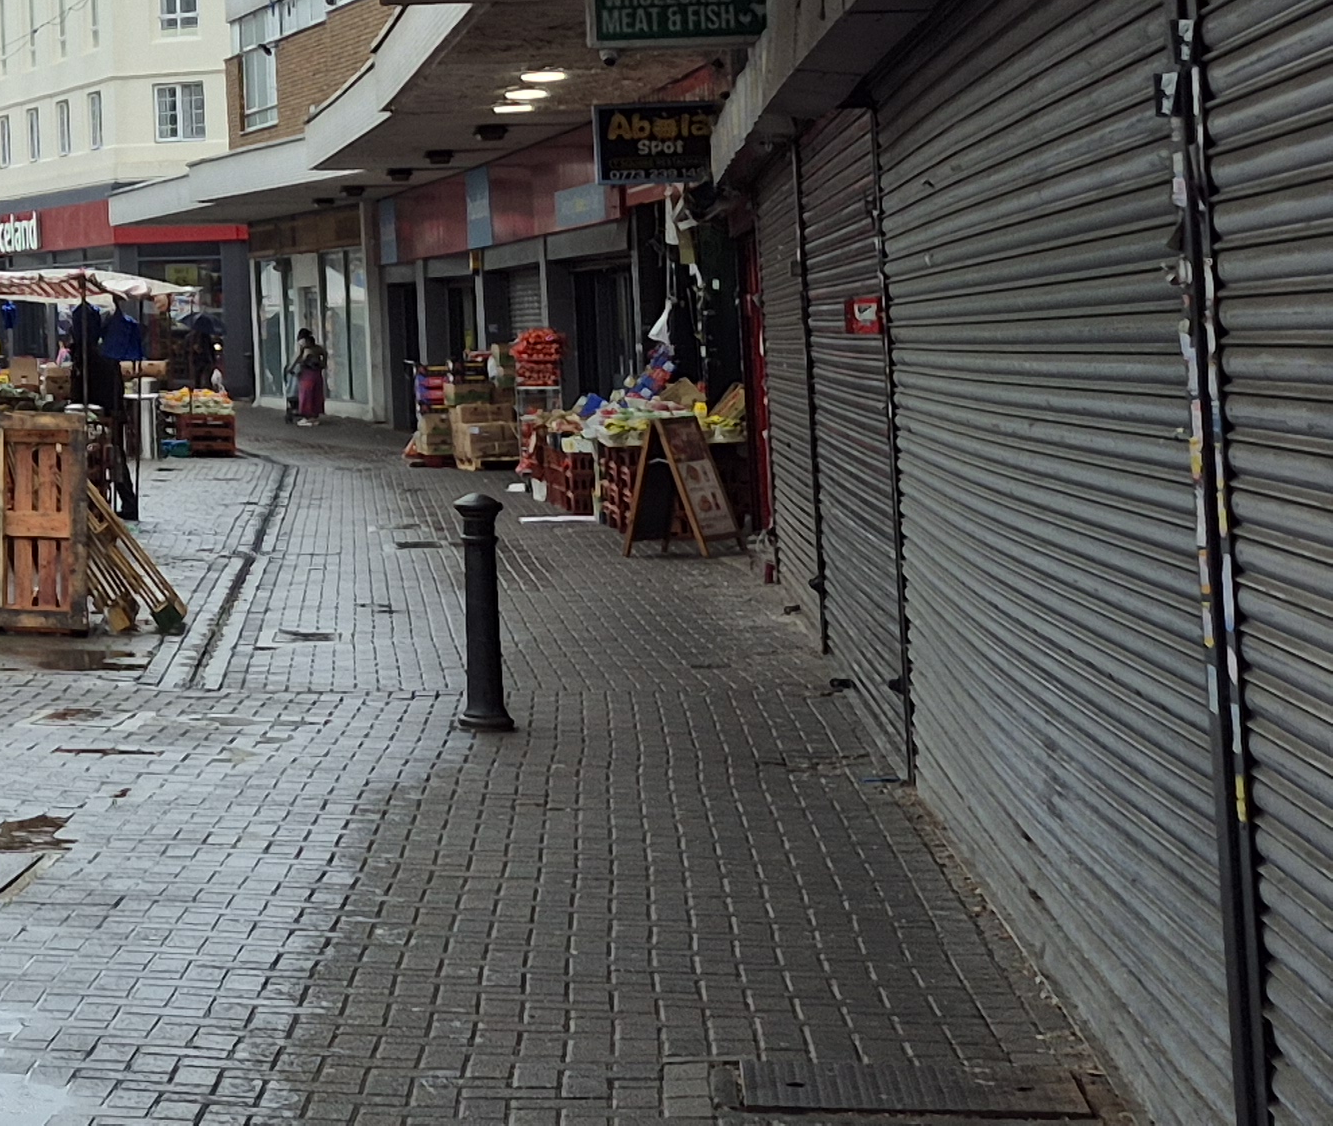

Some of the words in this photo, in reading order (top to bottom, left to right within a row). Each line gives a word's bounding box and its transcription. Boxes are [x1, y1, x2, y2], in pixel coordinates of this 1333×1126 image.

[601, 6, 661, 34] MEAT
[667, 6, 682, 31] &
[687, 4, 735, 30] FISH
